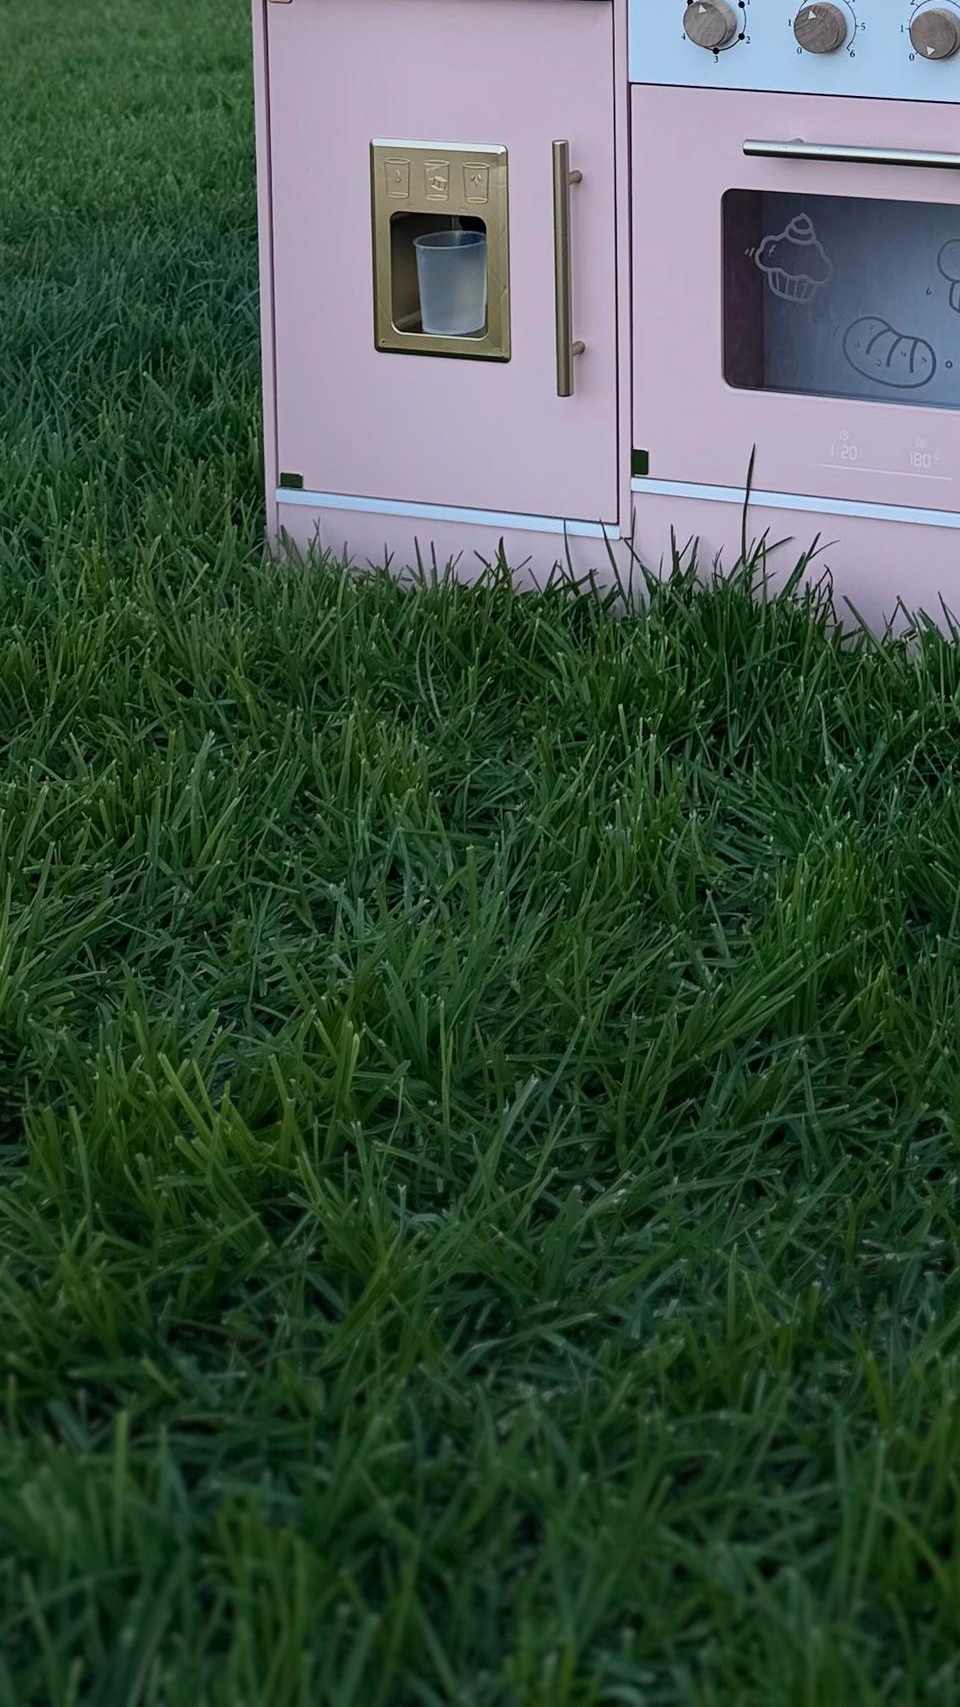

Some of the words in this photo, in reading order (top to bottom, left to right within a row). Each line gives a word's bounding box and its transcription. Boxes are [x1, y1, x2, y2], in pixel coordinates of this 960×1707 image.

[861, 23, 866, 31] 5
[746, 36, 750, 44] 2
[849, 50, 855, 58] 6
